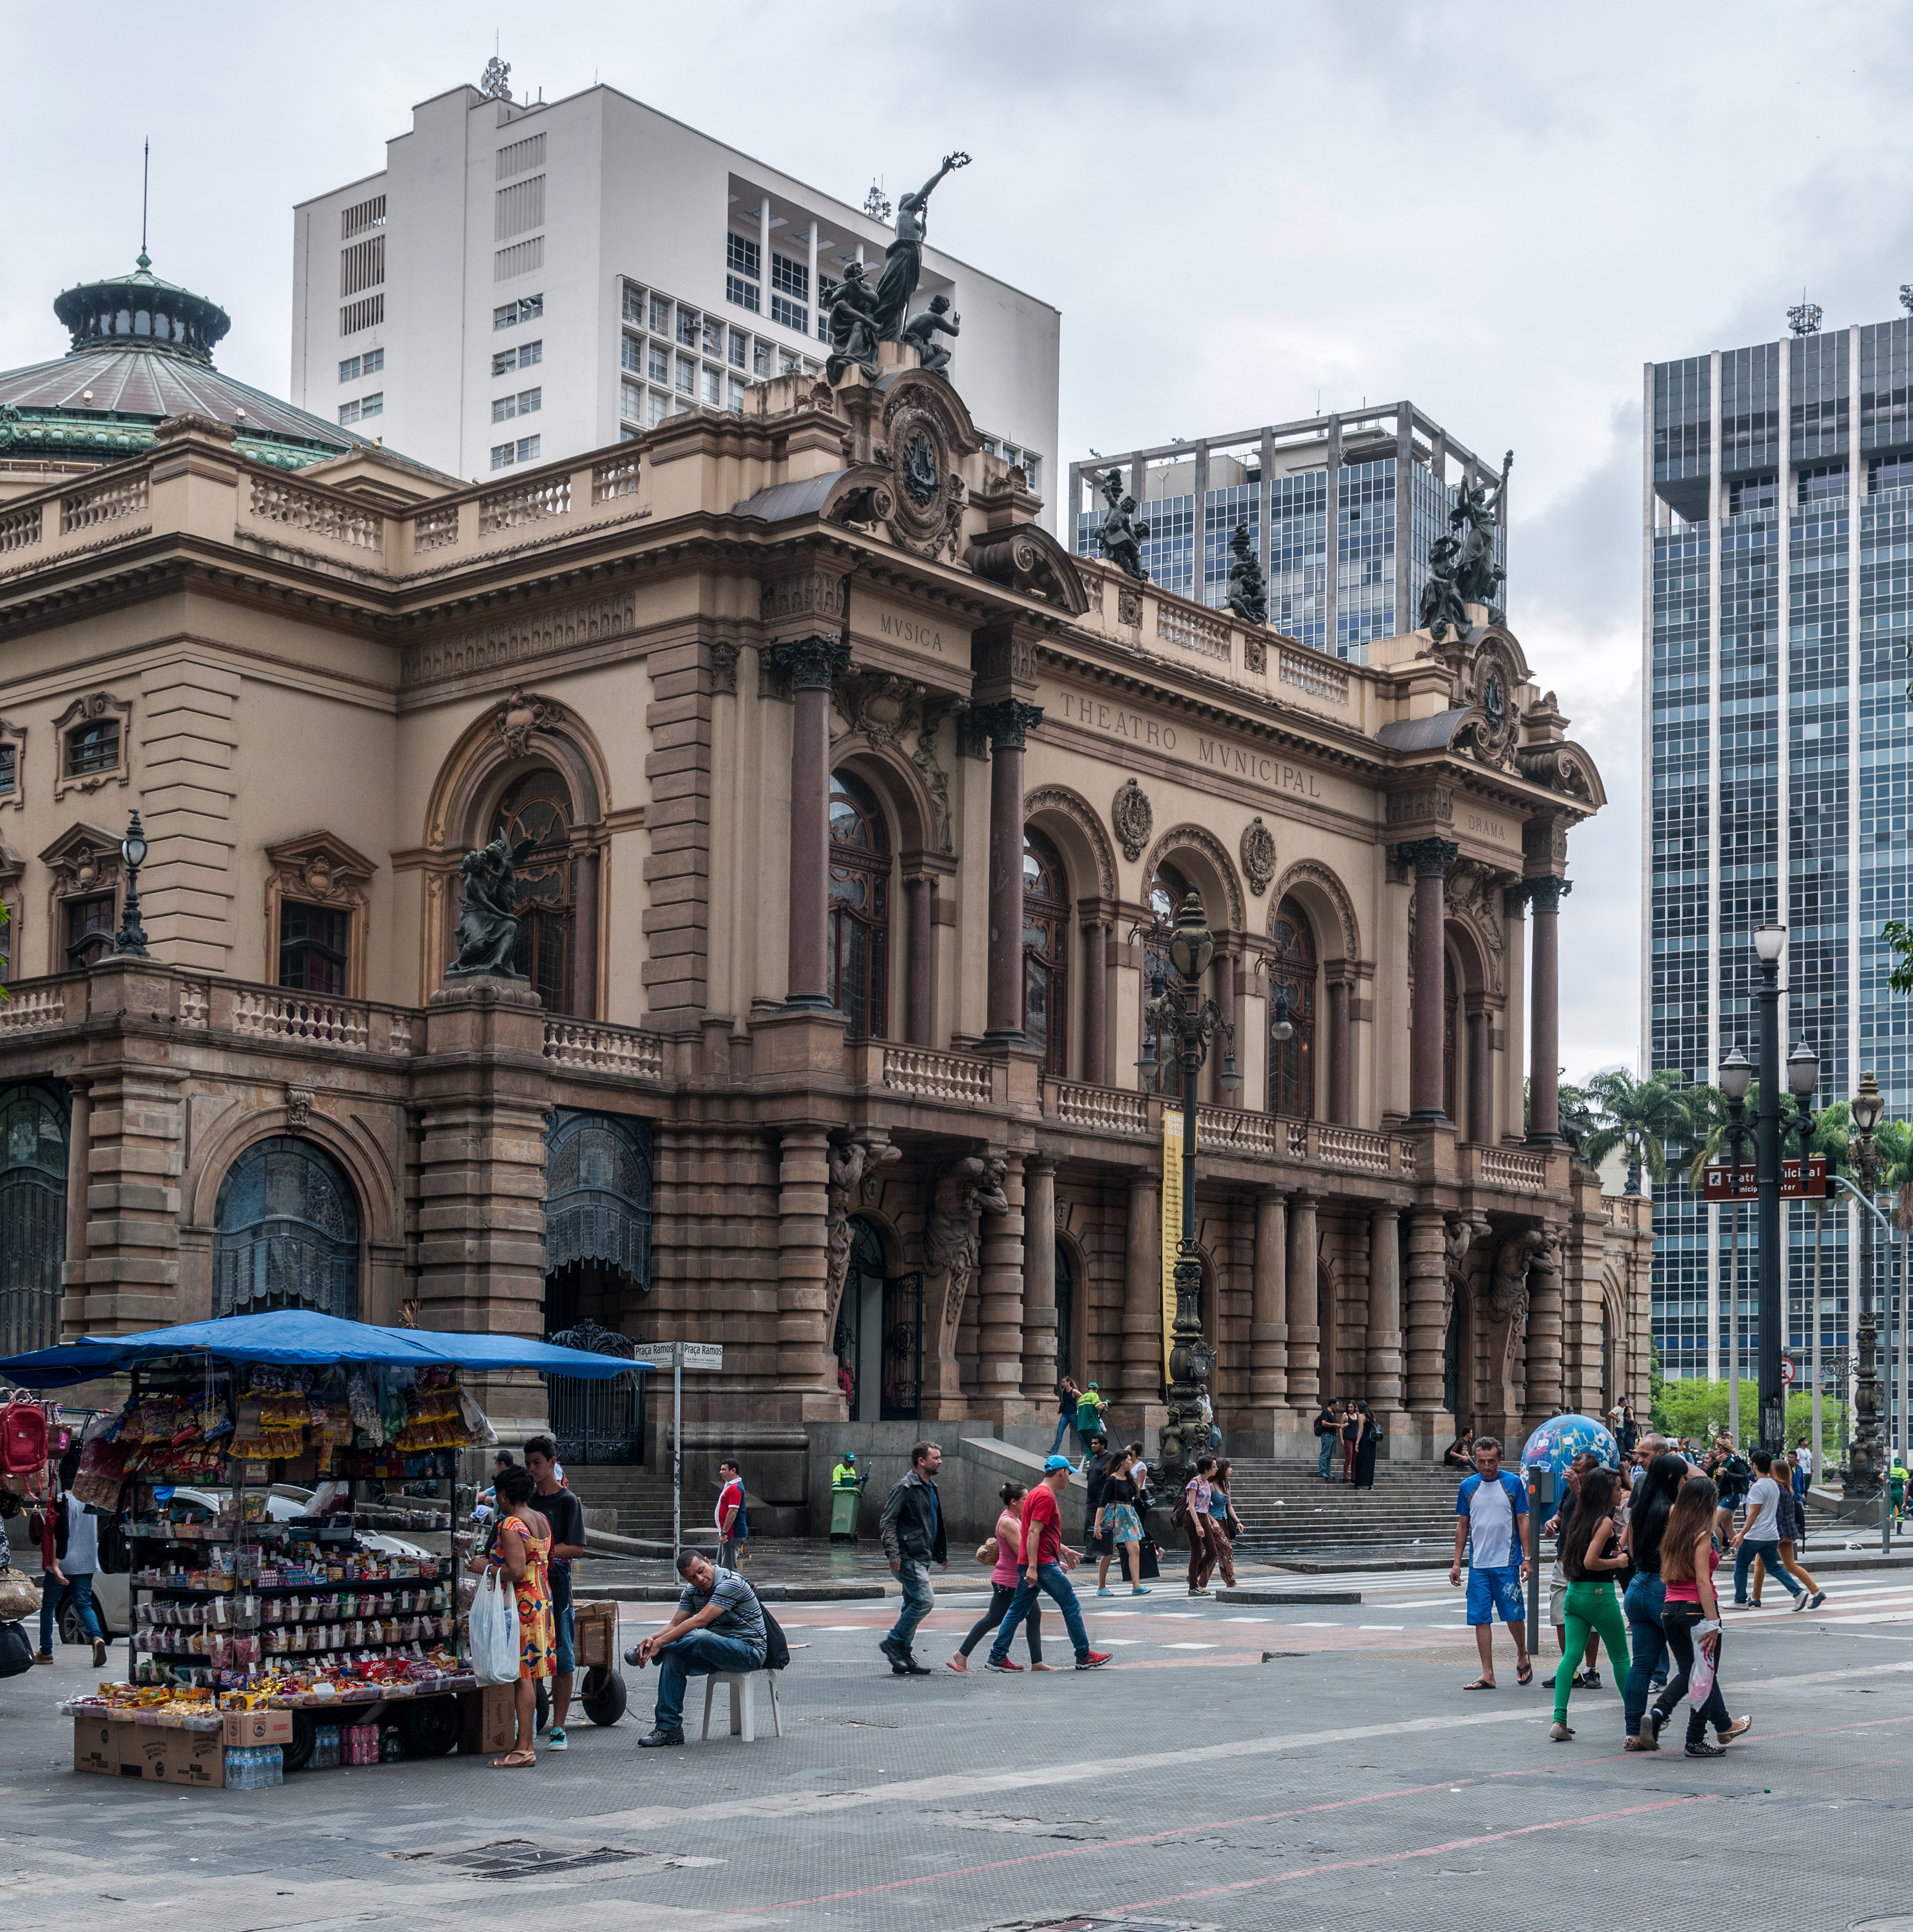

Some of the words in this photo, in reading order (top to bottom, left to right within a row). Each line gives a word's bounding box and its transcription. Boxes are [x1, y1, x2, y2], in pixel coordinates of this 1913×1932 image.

[880, 613, 942, 652] MVSICA
[1060, 692, 1176, 749] THEATRO
[1198, 738, 1320, 798] MVNICIPAL
[1469, 815, 1505, 840] DRAMA
[1727, 1173, 1754, 1183] Tatr
[636, 1347, 651, 1358] Praça
[654, 1345, 673, 1354] Ramos
[685, 1344, 700, 1356] Praça
[702, 1345, 722, 1355] Ramos
[145, 1747, 161, 1755] CROCANTE
[192, 1743, 211, 1752] CROCANTE
